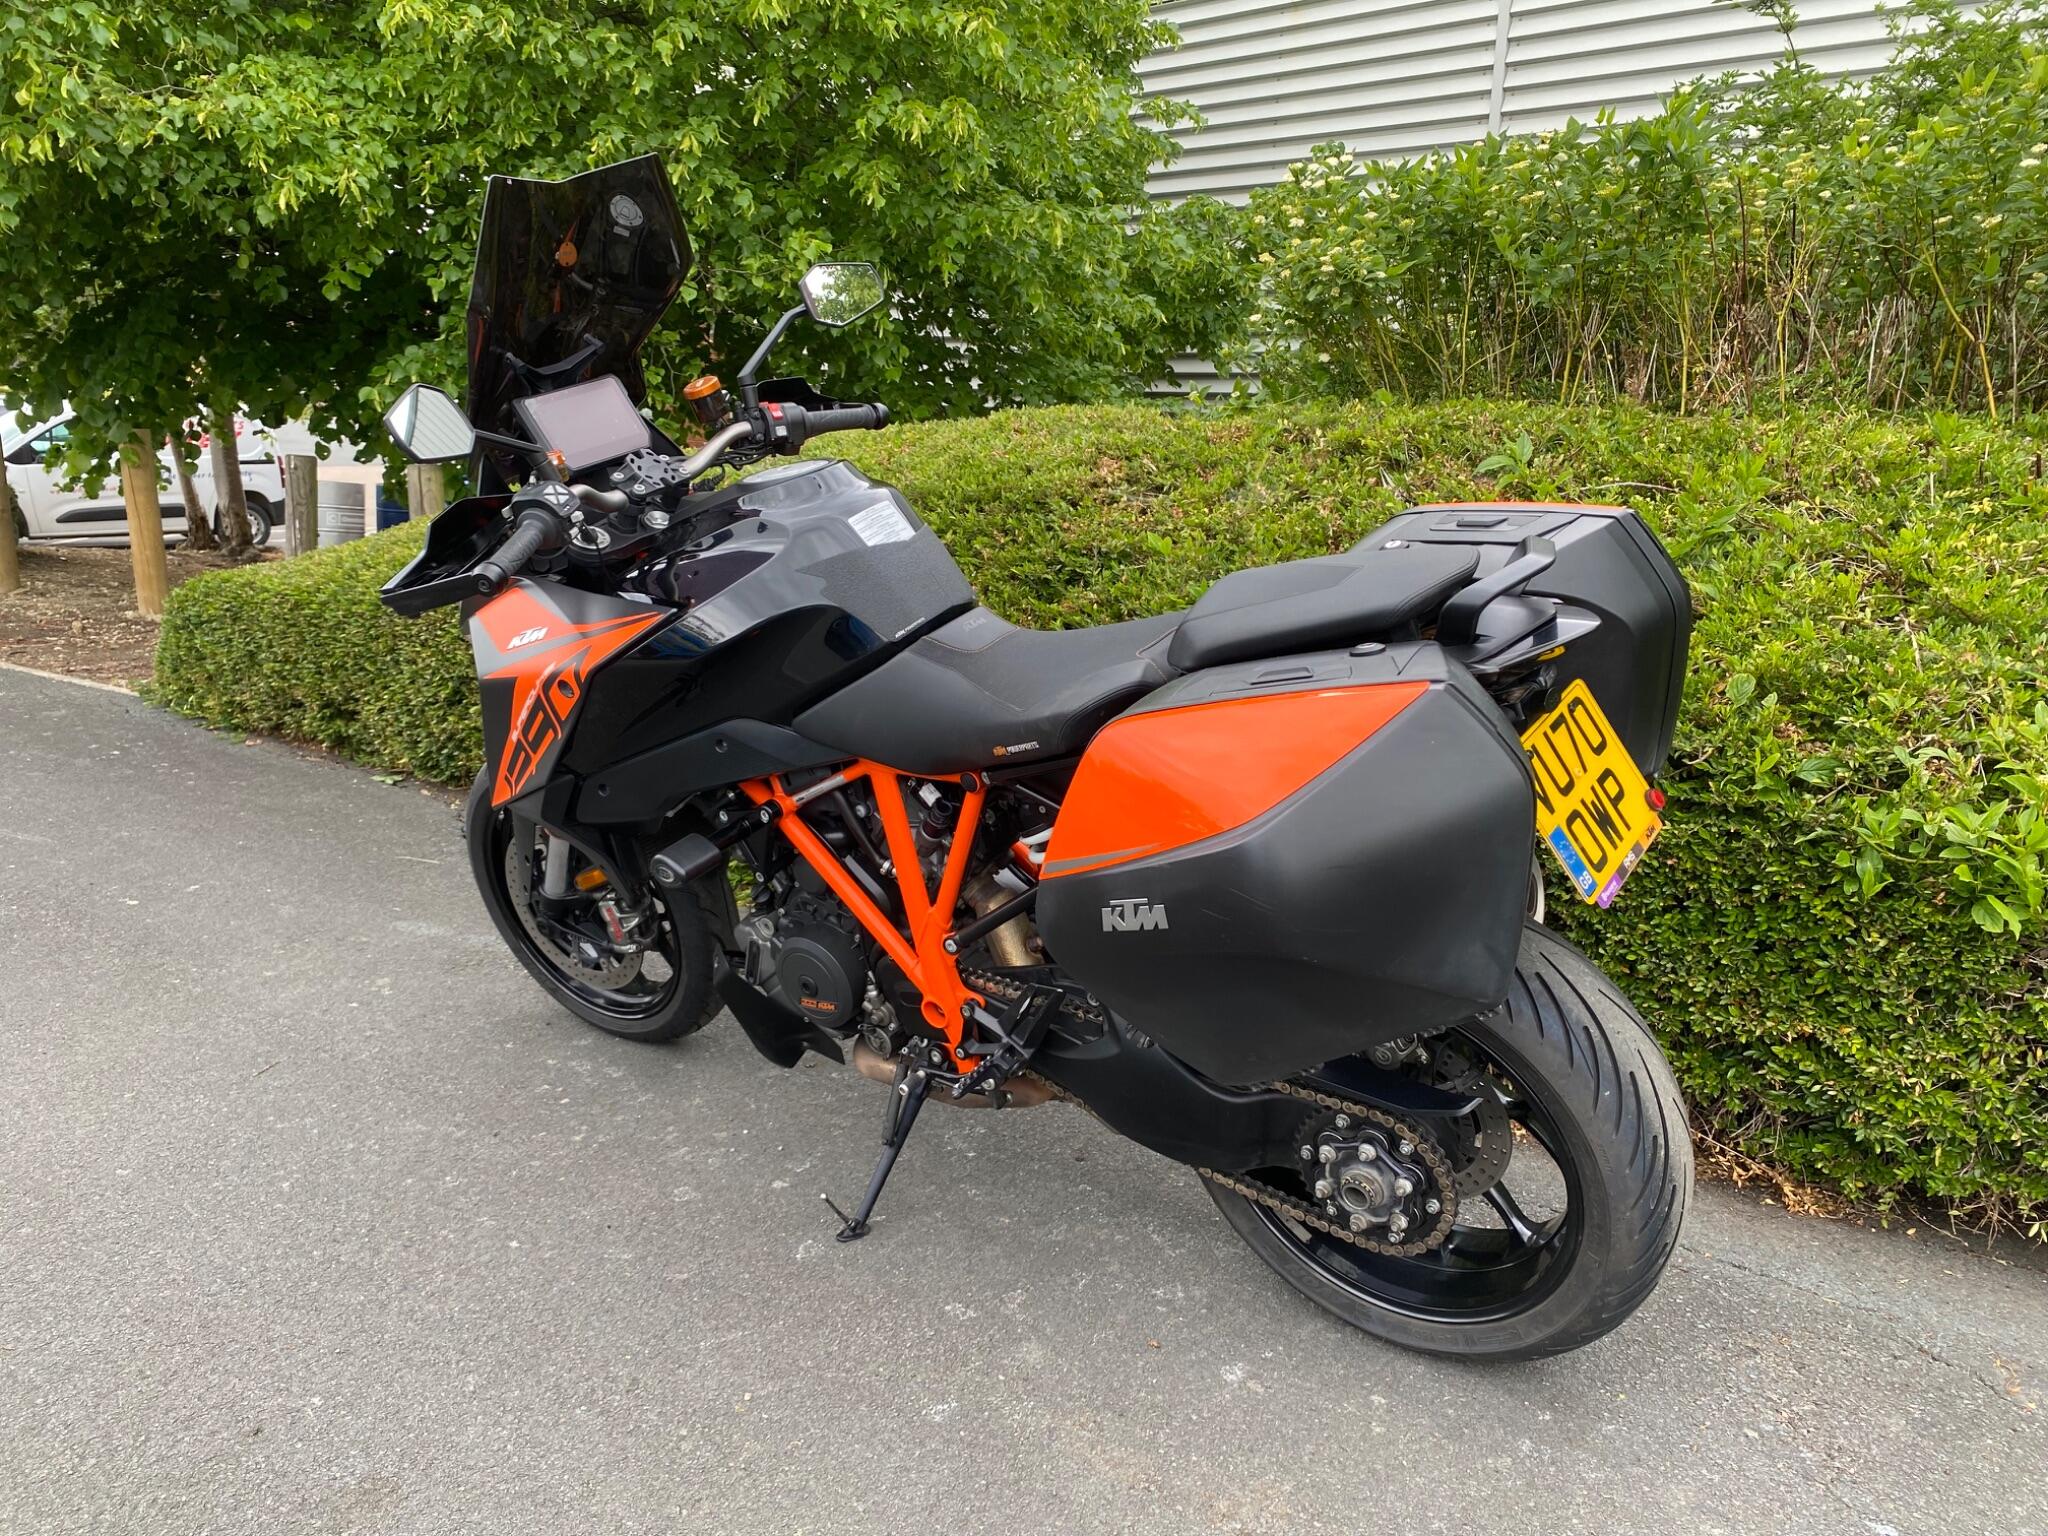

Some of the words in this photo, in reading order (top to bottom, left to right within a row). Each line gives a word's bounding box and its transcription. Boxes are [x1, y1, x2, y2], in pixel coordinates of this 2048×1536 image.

[506, 626, 549, 650] KTM
[1565, 767, 1632, 874] OWP
[1578, 869, 1593, 890] GB
[1101, 897, 1169, 932] KTM
